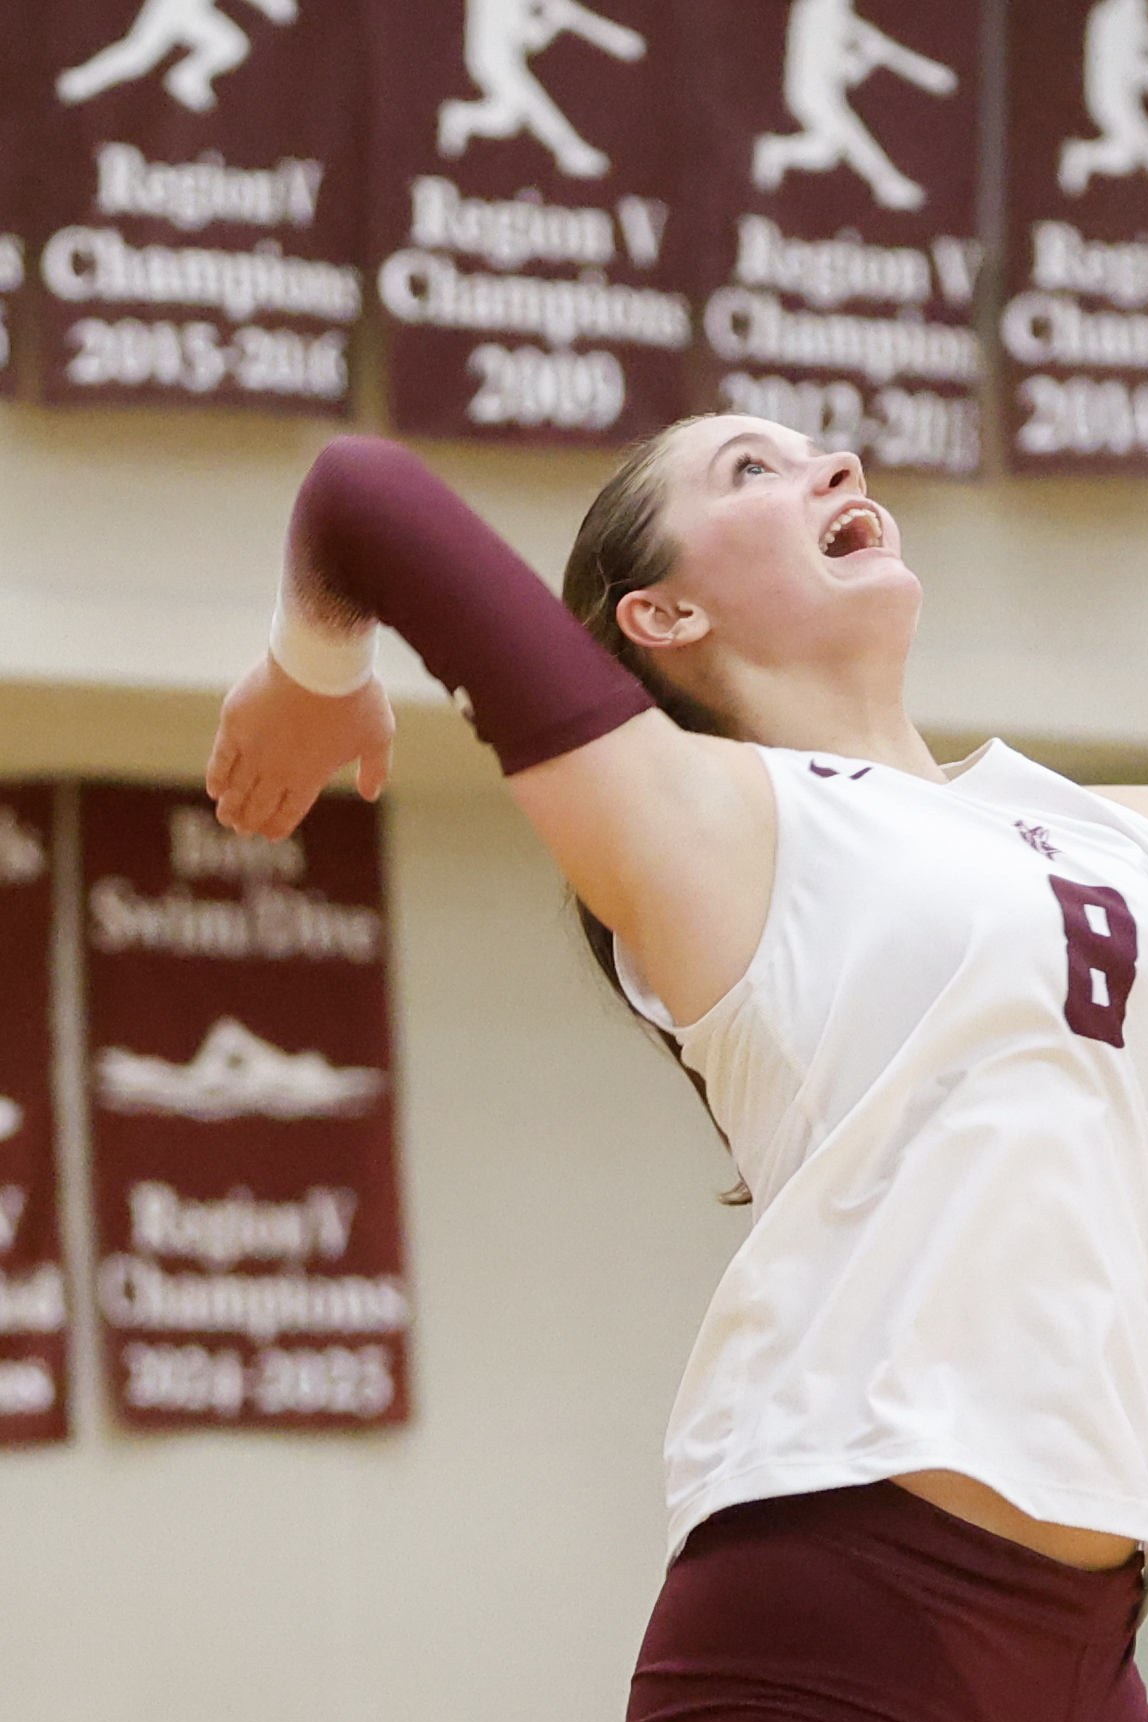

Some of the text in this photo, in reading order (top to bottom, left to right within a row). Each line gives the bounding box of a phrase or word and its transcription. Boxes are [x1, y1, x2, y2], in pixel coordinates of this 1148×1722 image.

[97, 141, 280, 232] Region
[411, 175, 668, 273] Region V
[41, 226, 361, 321] Champions
[378, 248, 692, 348] Champions
[737, 214, 932, 308] Region
[130, 1181, 307, 1264] Region
[98, 1252, 410, 1345] Champions
